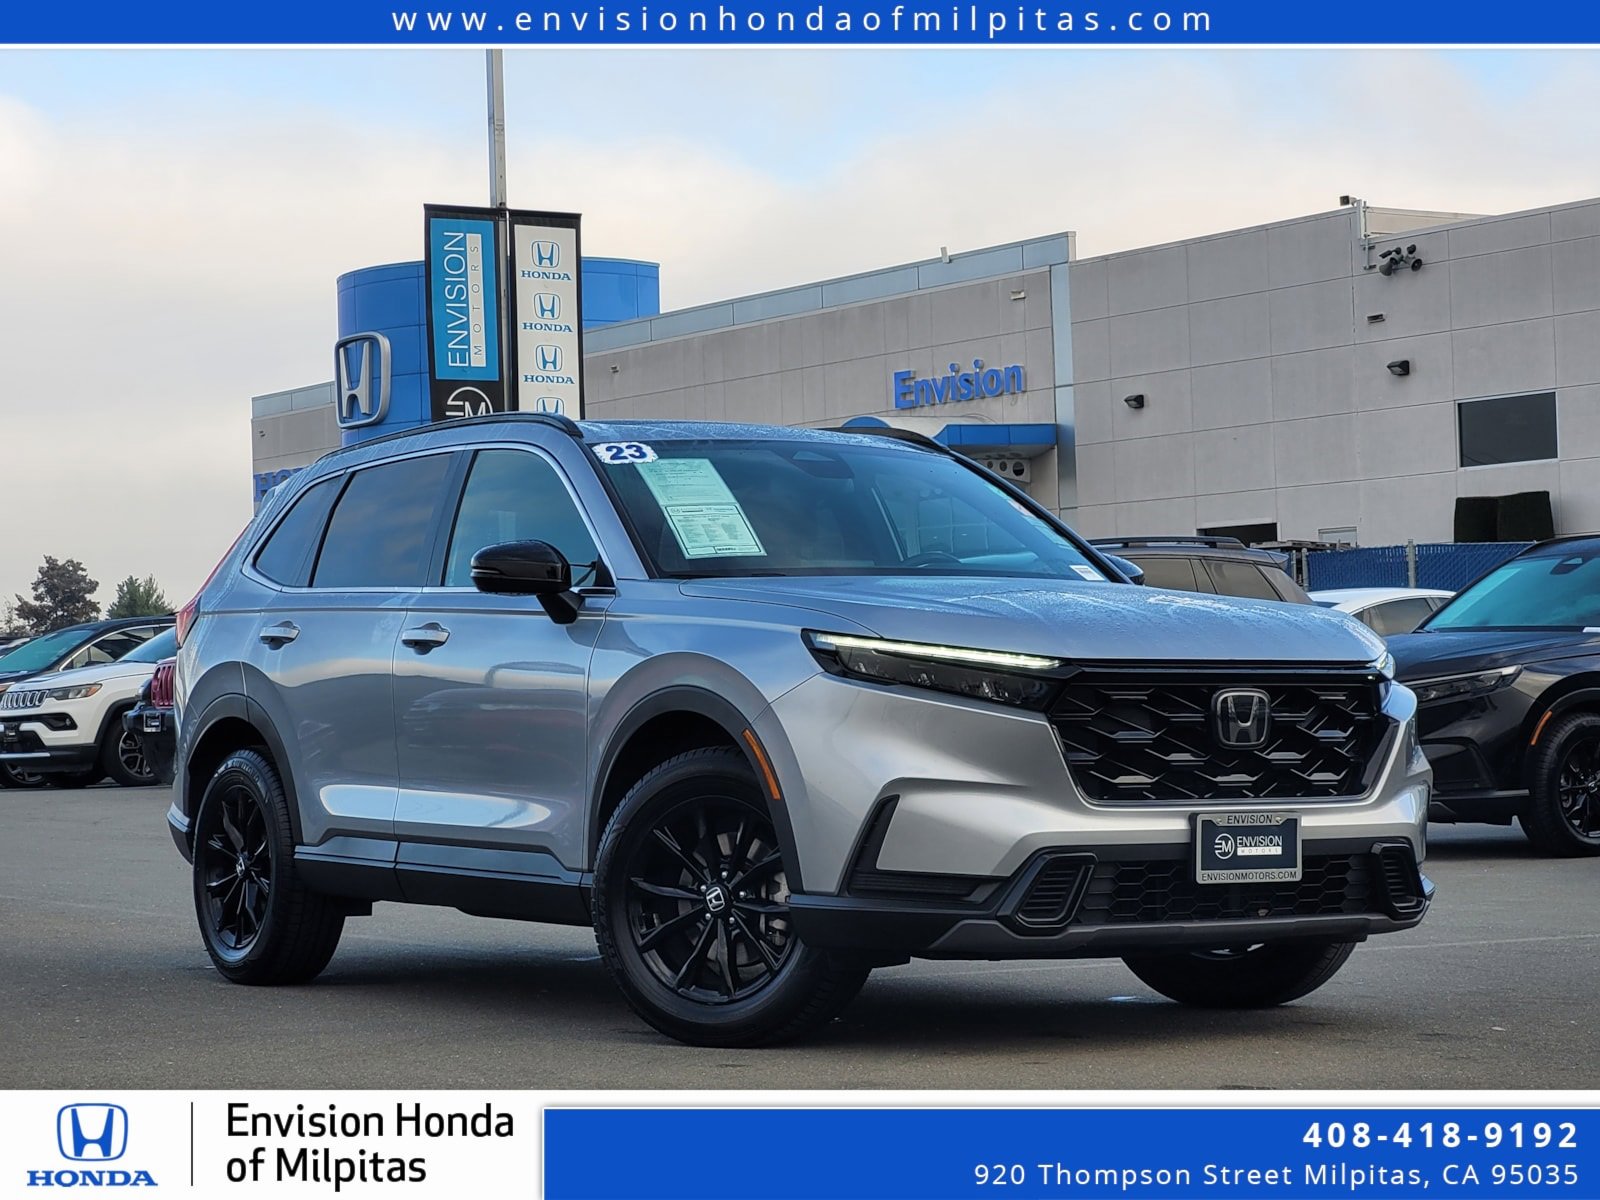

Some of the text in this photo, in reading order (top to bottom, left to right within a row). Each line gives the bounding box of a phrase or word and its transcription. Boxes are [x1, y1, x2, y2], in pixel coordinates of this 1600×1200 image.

[520, 270, 571, 281] HONDA
[444, 231, 468, 367] ENVISION
[470, 245, 484, 356] MOTORS
[522, 322, 573, 333] HONDA
[523, 374, 575, 385] HONDA
[893, 359, 1024, 410] Envision
[606, 445, 648, 460] 23
[1227, 815, 1273, 824] ENVISION
[1237, 836, 1282, 847] ENVISION
[1201, 871, 1297, 882] ENVISIONMOTORS.COM
